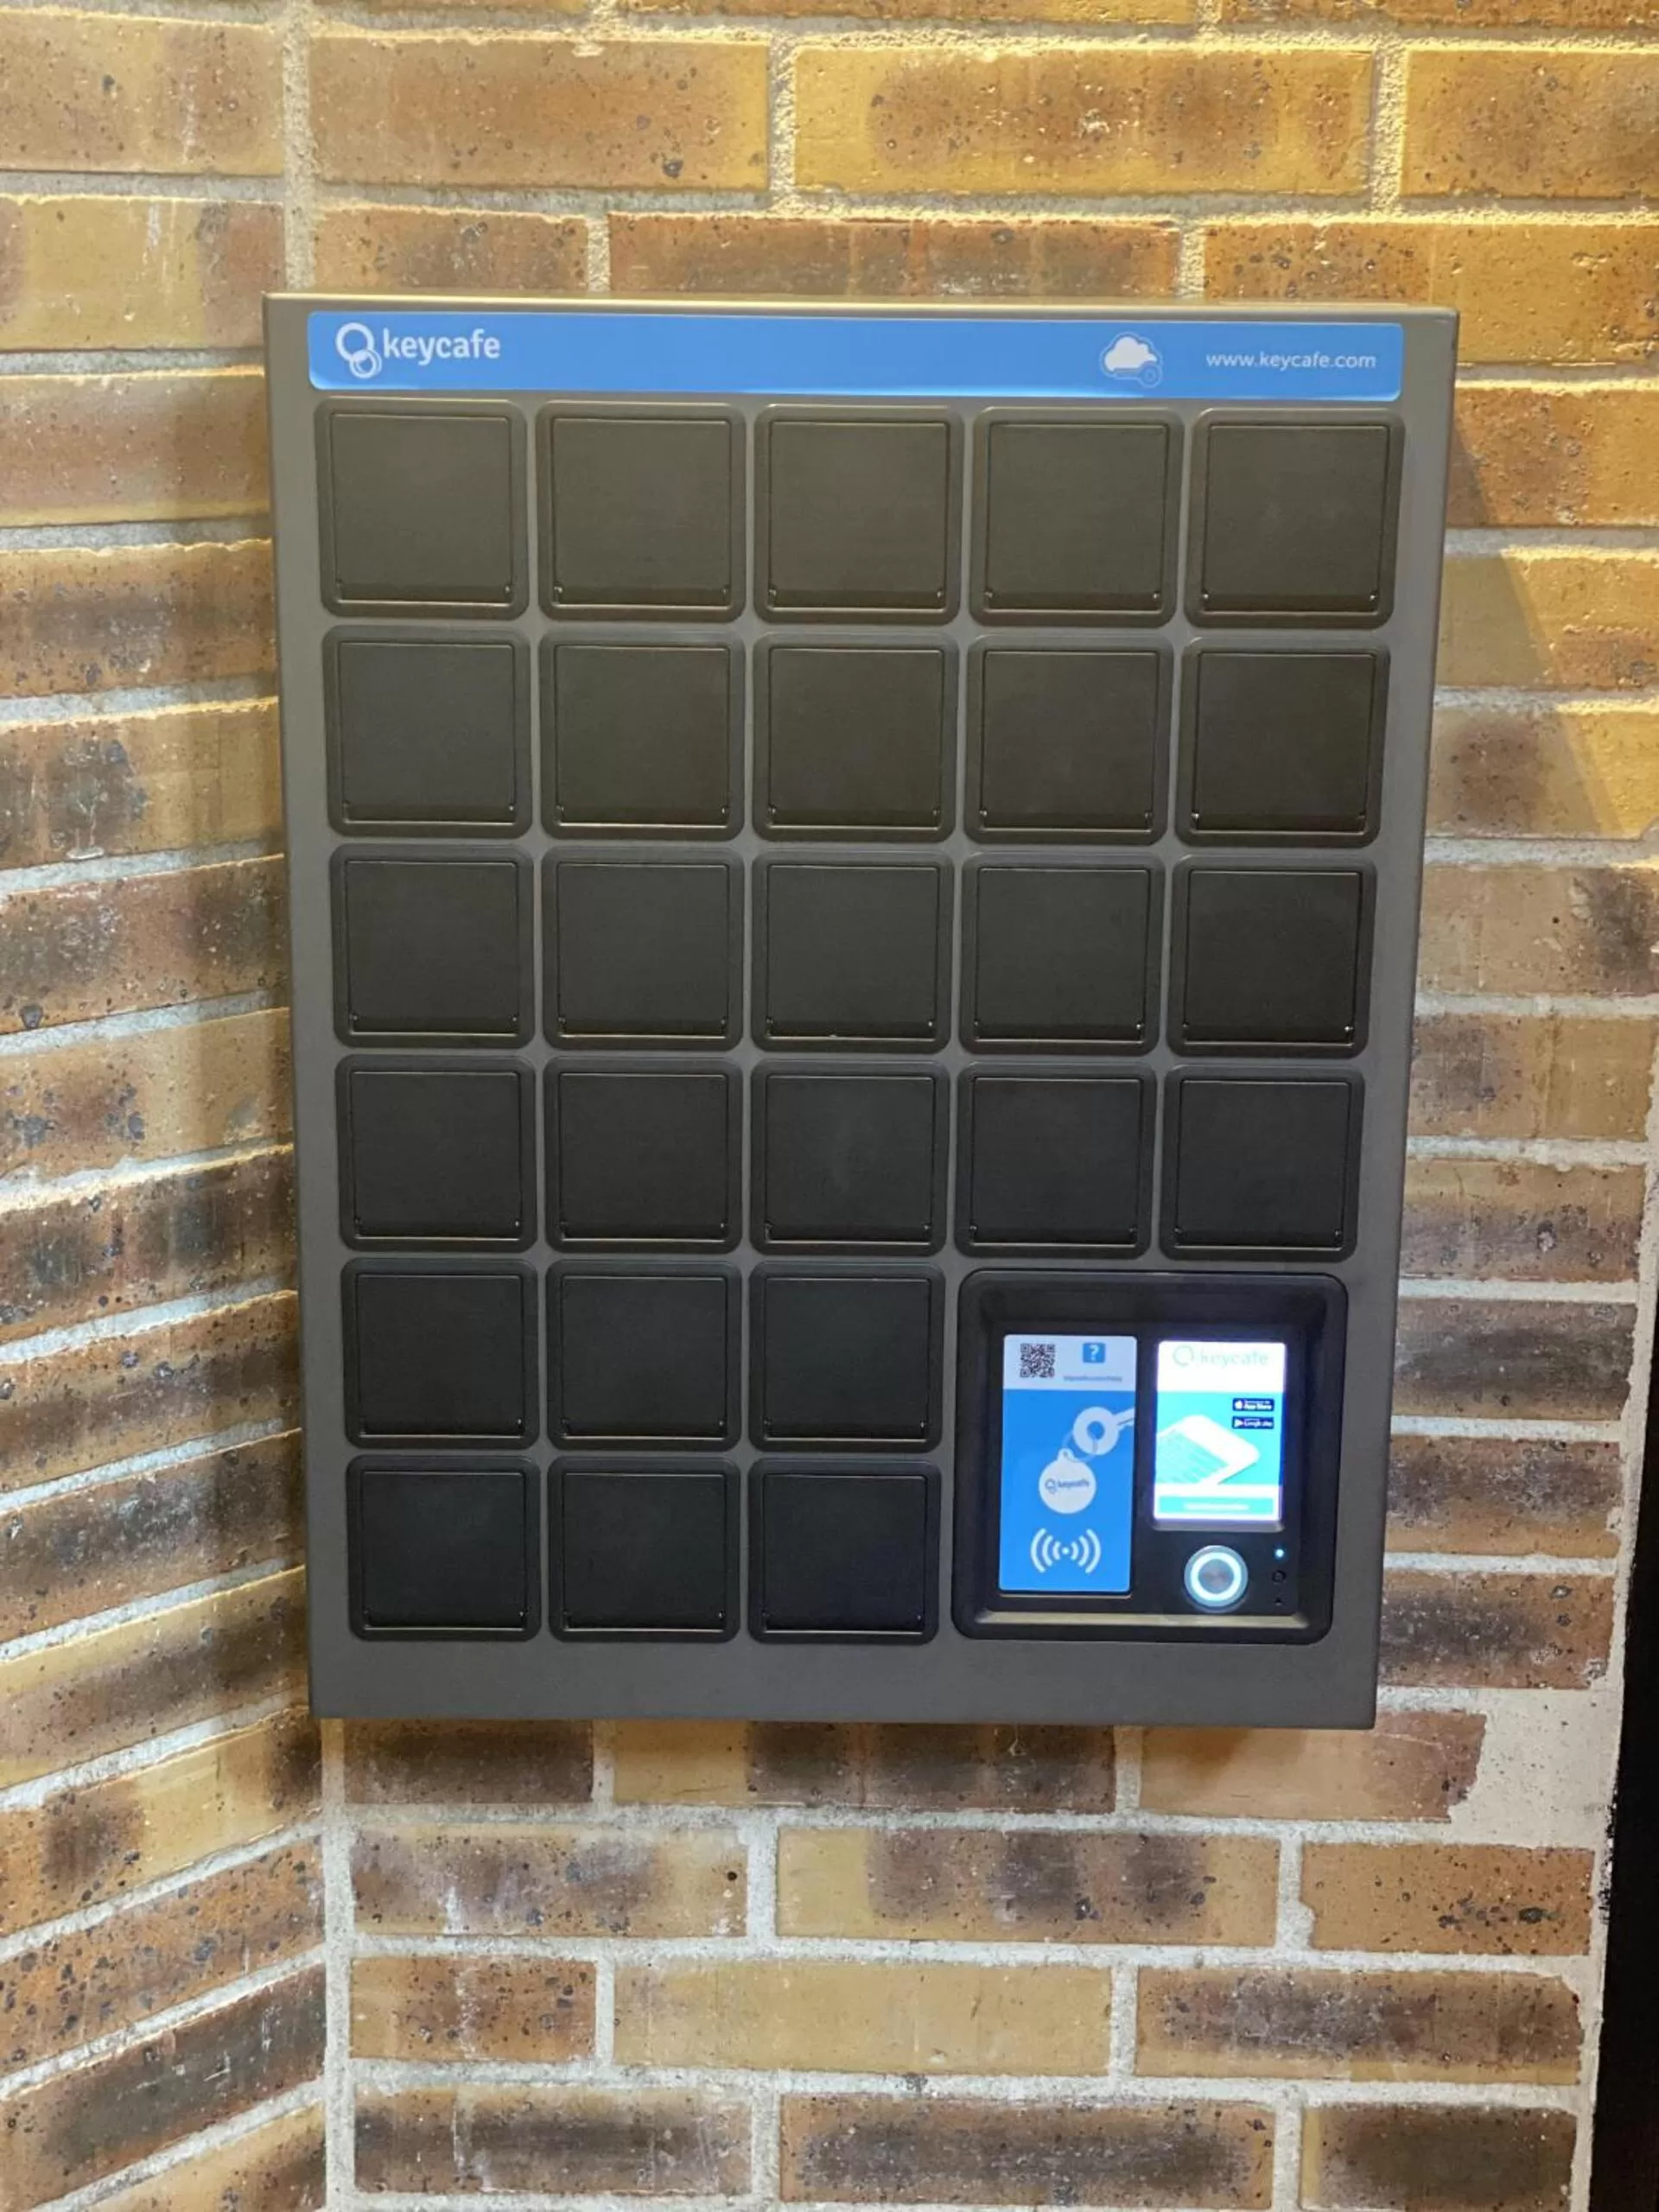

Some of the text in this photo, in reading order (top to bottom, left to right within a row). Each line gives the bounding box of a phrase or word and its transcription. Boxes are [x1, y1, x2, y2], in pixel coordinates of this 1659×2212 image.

[382, 327, 501, 366] keycafe
[1205, 351, 1376, 372] www.keycafe.com
[1199, 1349, 1269, 1369] keycafe
